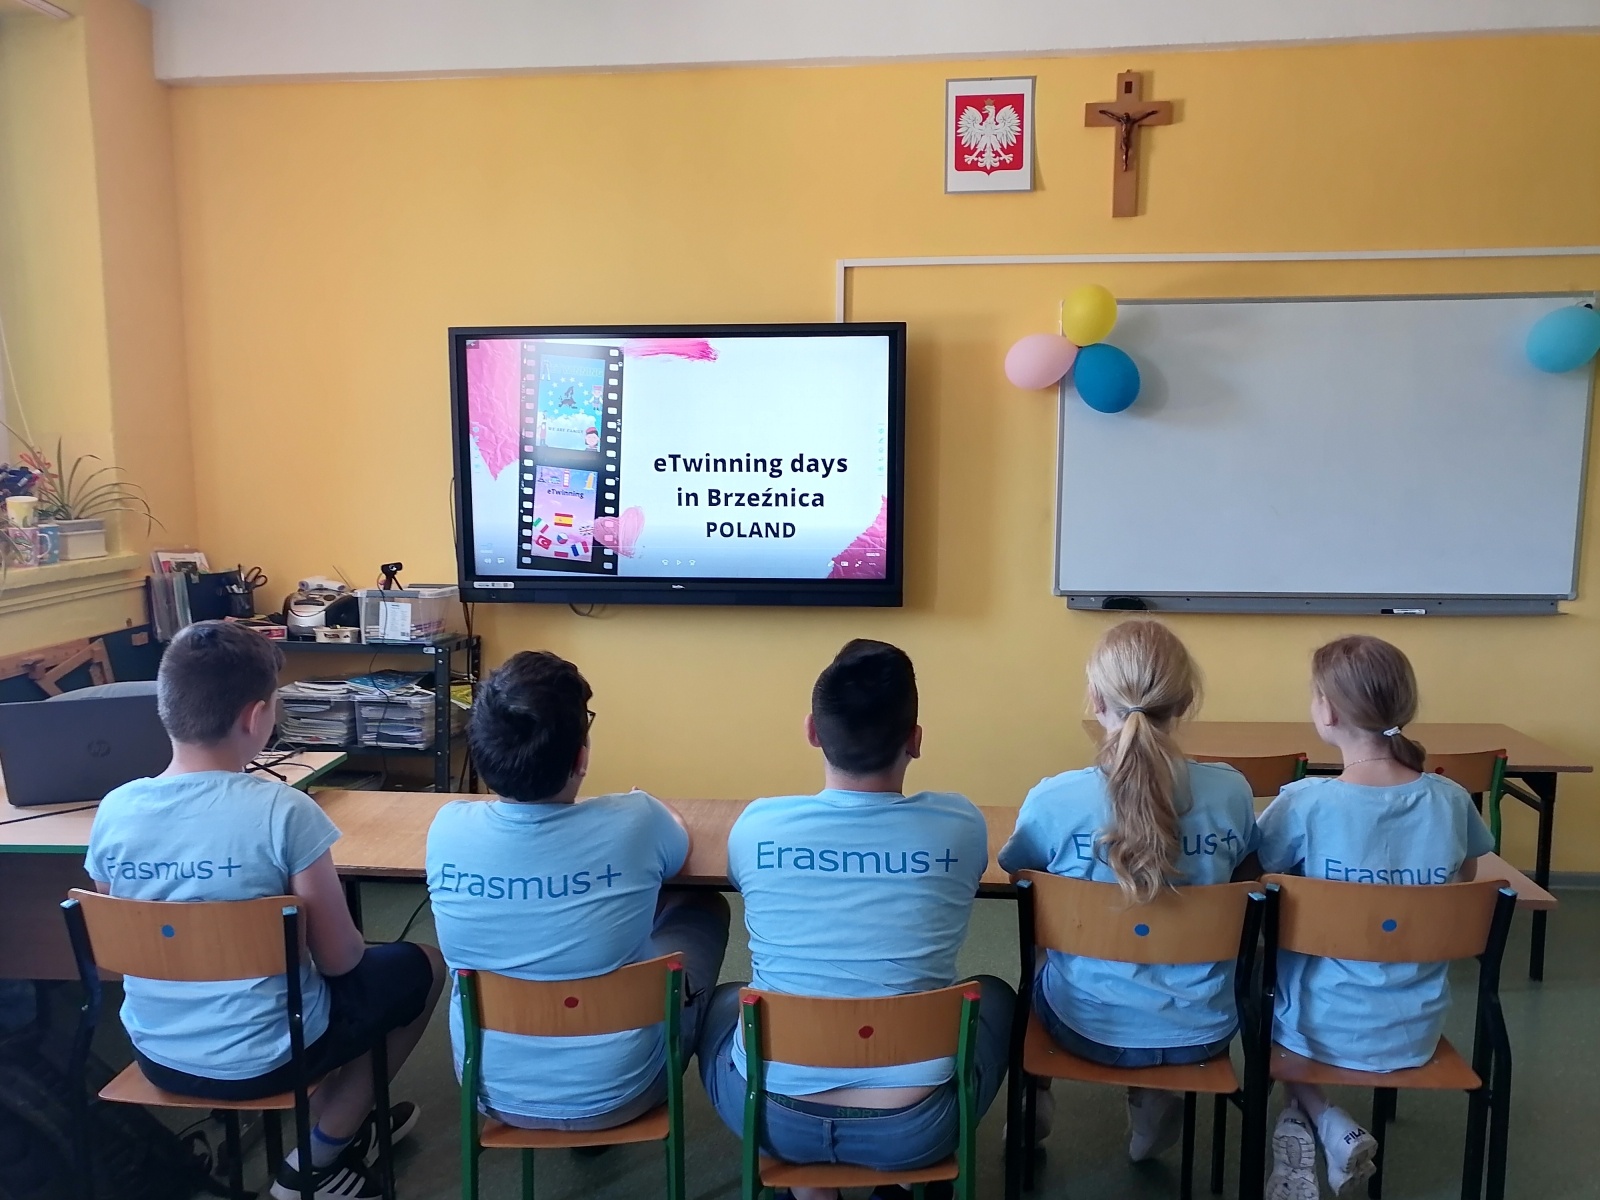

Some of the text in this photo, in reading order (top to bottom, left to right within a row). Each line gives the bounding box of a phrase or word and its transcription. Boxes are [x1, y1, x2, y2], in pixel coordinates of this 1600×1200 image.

[654, 453, 848, 478] eTwinning days
[547, 488, 584, 499] eTwinning
[677, 487, 825, 507] in Brzeźnica
[706, 522, 796, 539] POLAND
[759, 840, 959, 874] Erasmus+
[439, 863, 622, 900] Erasmus+
[1343, 1128, 1366, 1145] FILA
